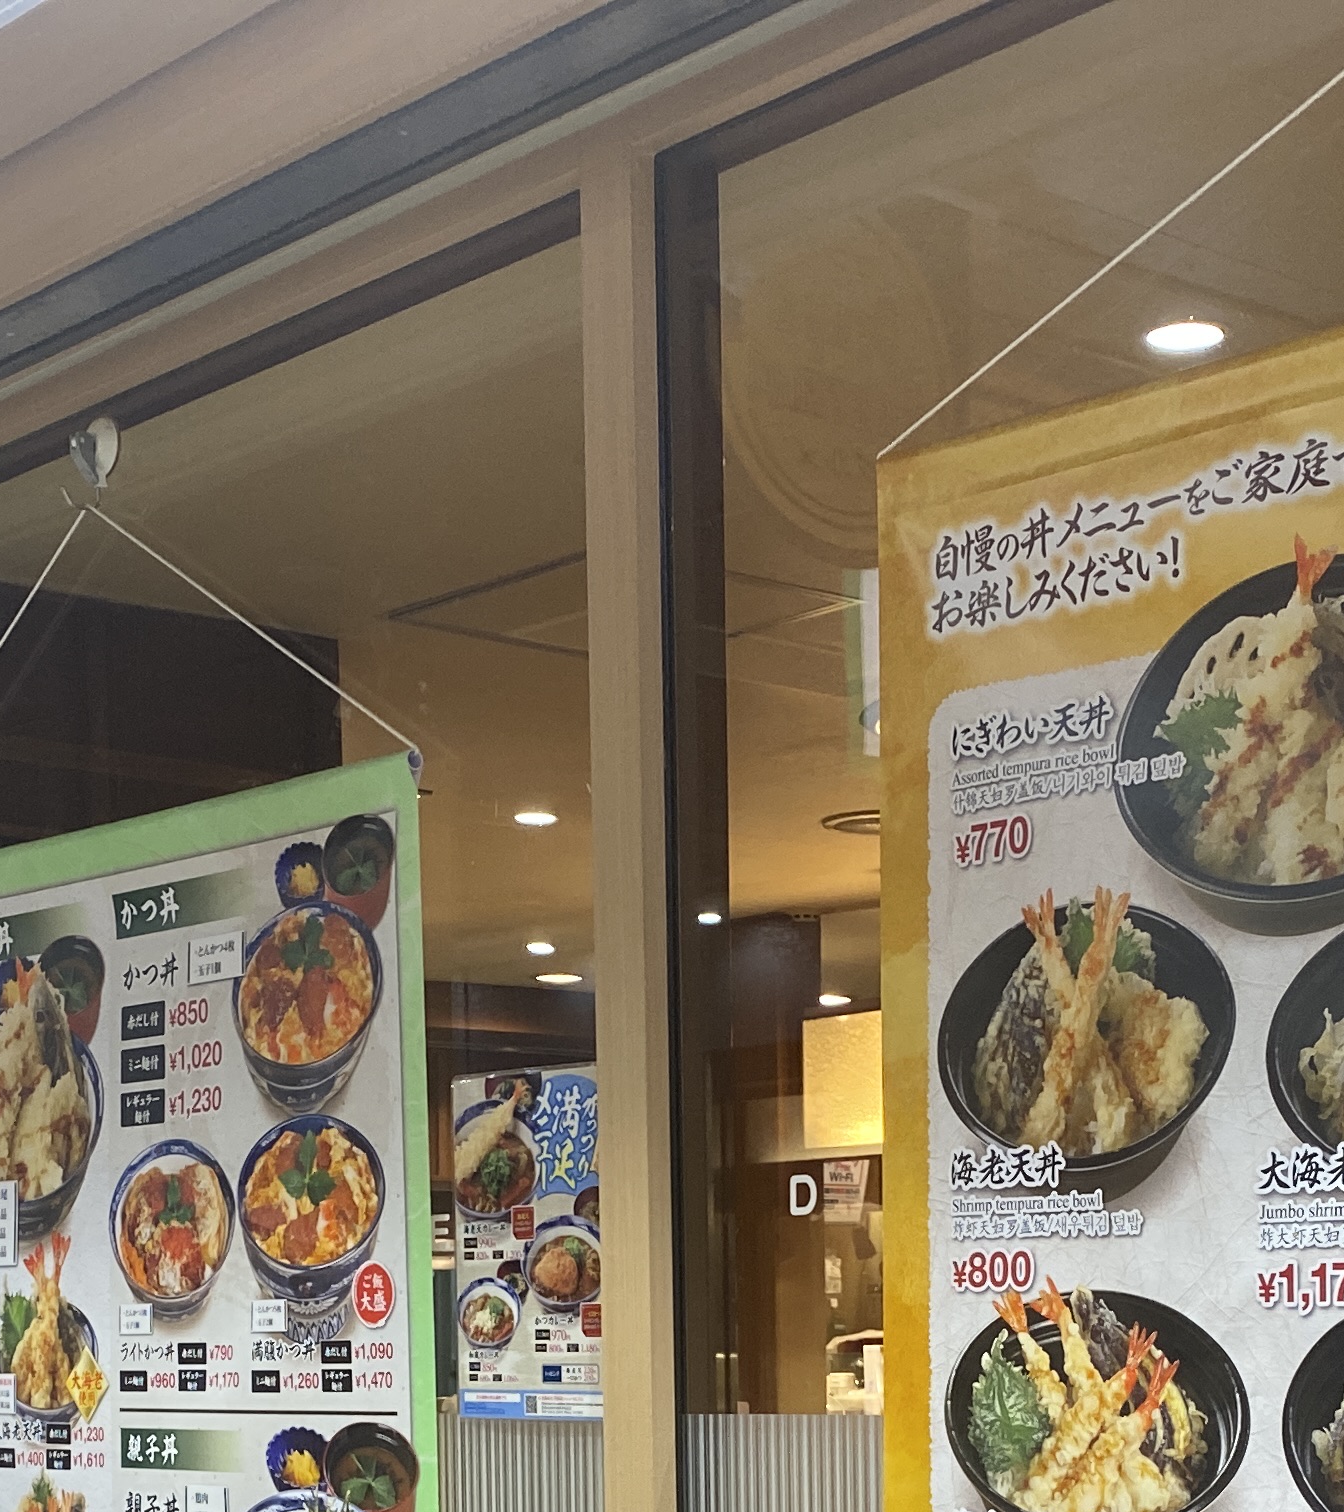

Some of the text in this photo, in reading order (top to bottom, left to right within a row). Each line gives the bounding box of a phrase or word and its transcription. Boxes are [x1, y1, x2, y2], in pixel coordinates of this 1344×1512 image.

[952, 696, 1110, 757] にぎわい天丼
[952, 744, 1115, 787] Assorted tempura rice bowl
[955, 816, 1029, 863] ¥770
[120, 886, 180, 930] かつ丼
[123, 952, 179, 991] かつ丼
[127, 998, 208, 1030] 赤だし付 ¥850
[169, 1041, 223, 1074] ¥1,020
[169, 1086, 222, 1119] ¥1,230
[951, 1146, 1062, 1186] 海老天丼
[1259, 1204, 1304, 1220] Jumbo
[362, 1273, 385, 1290] ご飯
[953, 1251, 1031, 1288] ¥800
[360, 1291, 387, 1313] 大盛
[120, 1342, 233, 1363] ライトかつ丼 ¥790
[252, 1338, 393, 1363] 満腹かつ丼 ¥1,090
[72, 1370, 103, 1391] 大海老
[73, 1427, 104, 1442] ¥1,230
[127, 1434, 179, 1466] 親子丼
[74, 1452, 104, 1468] ¥1,610
